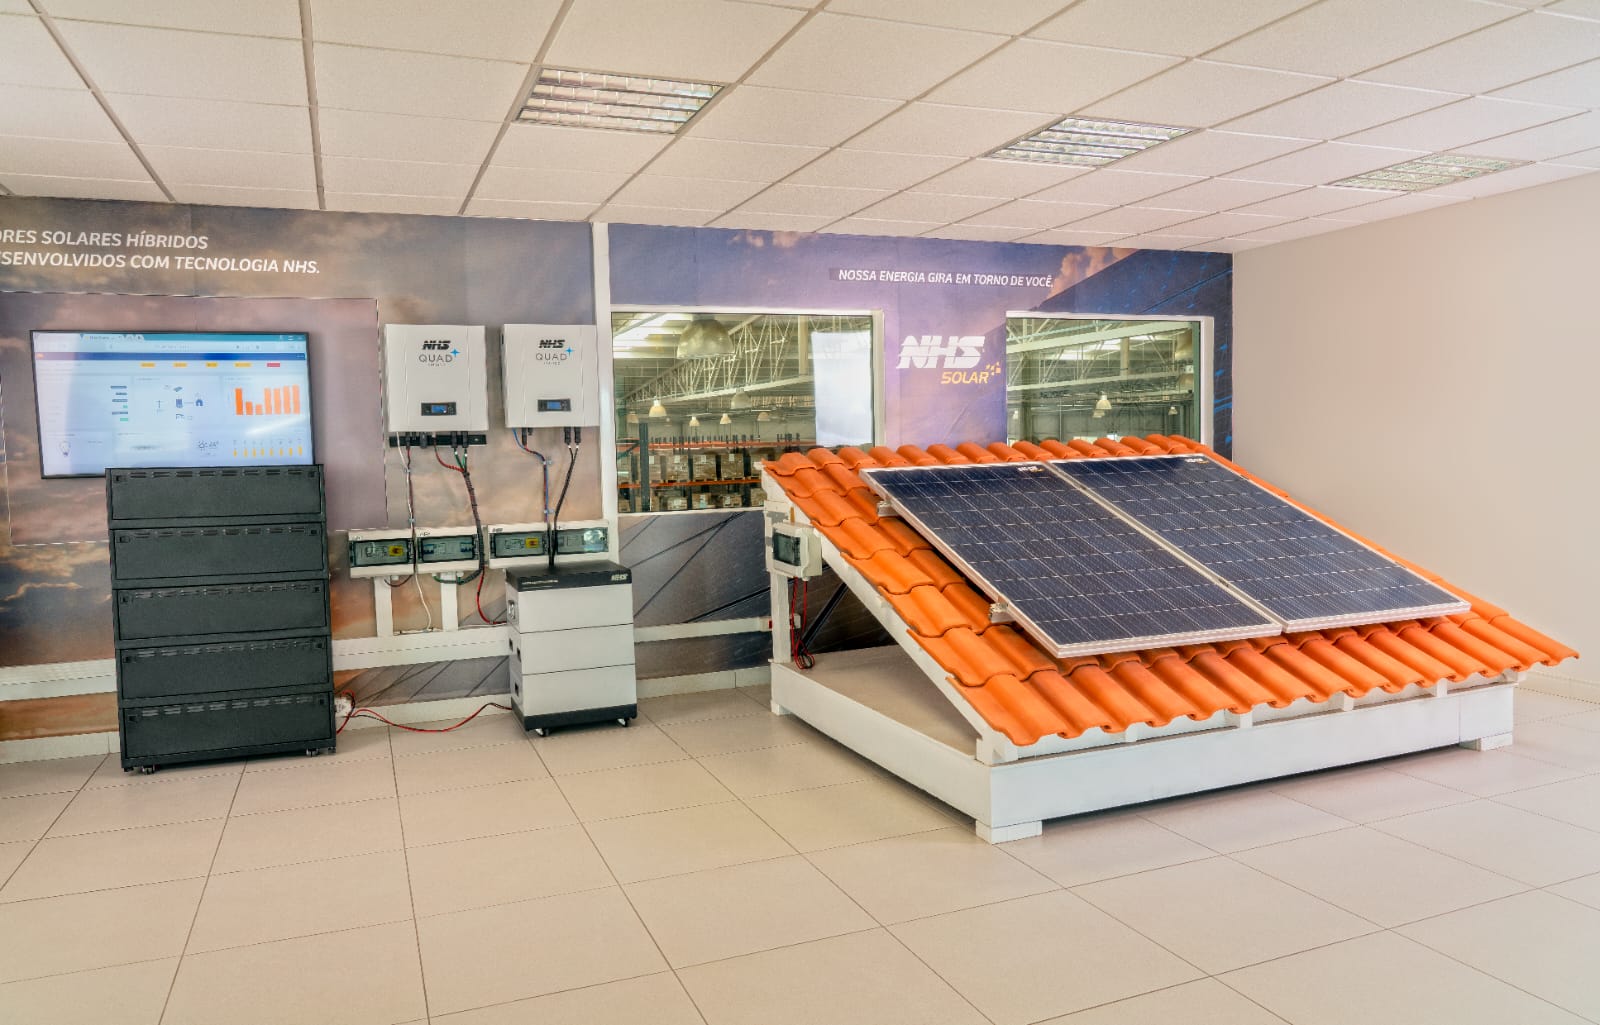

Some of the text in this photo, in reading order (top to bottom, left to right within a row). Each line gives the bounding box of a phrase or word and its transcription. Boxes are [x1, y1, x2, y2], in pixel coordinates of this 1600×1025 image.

[0, 229, 208, 249] RES SOLARES HÍBRIDOS
[0, 251, 320, 274] SENVOLVIDOS COM TECNOLOGIA NHS.
[838, 269, 1054, 288] NOSSA ENERGIA GIRA EM TORNO DE VOCÊ.
[422, 340, 451, 350] NHS
[539, 339, 565, 349] NHS
[418, 353, 453, 363] QUAD
[535, 352, 568, 361] QUAD
[896, 335, 985, 369] NHS
[940, 371, 989, 384] SOLAR
